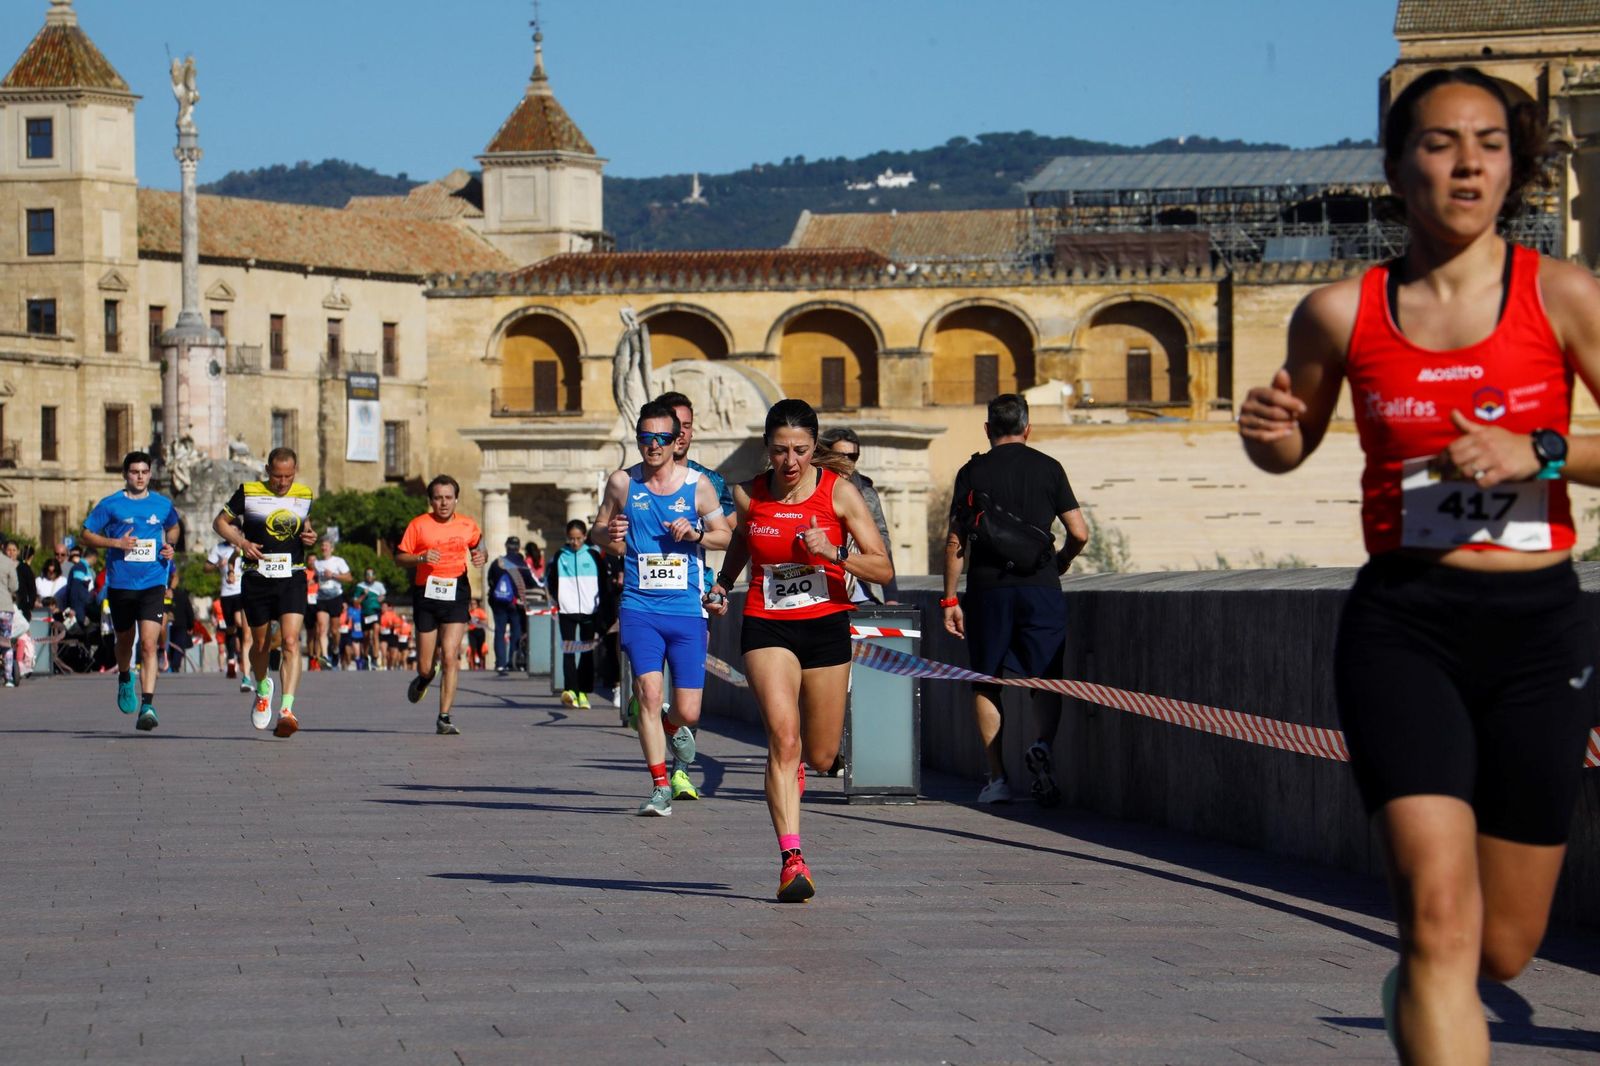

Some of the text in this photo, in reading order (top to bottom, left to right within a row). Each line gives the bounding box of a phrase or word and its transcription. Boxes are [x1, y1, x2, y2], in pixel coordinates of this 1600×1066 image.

[1437, 491, 1518, 521] 417
[753, 526, 779, 535] califas
[650, 569, 675, 579] 181
[775, 580, 812, 597] 240
